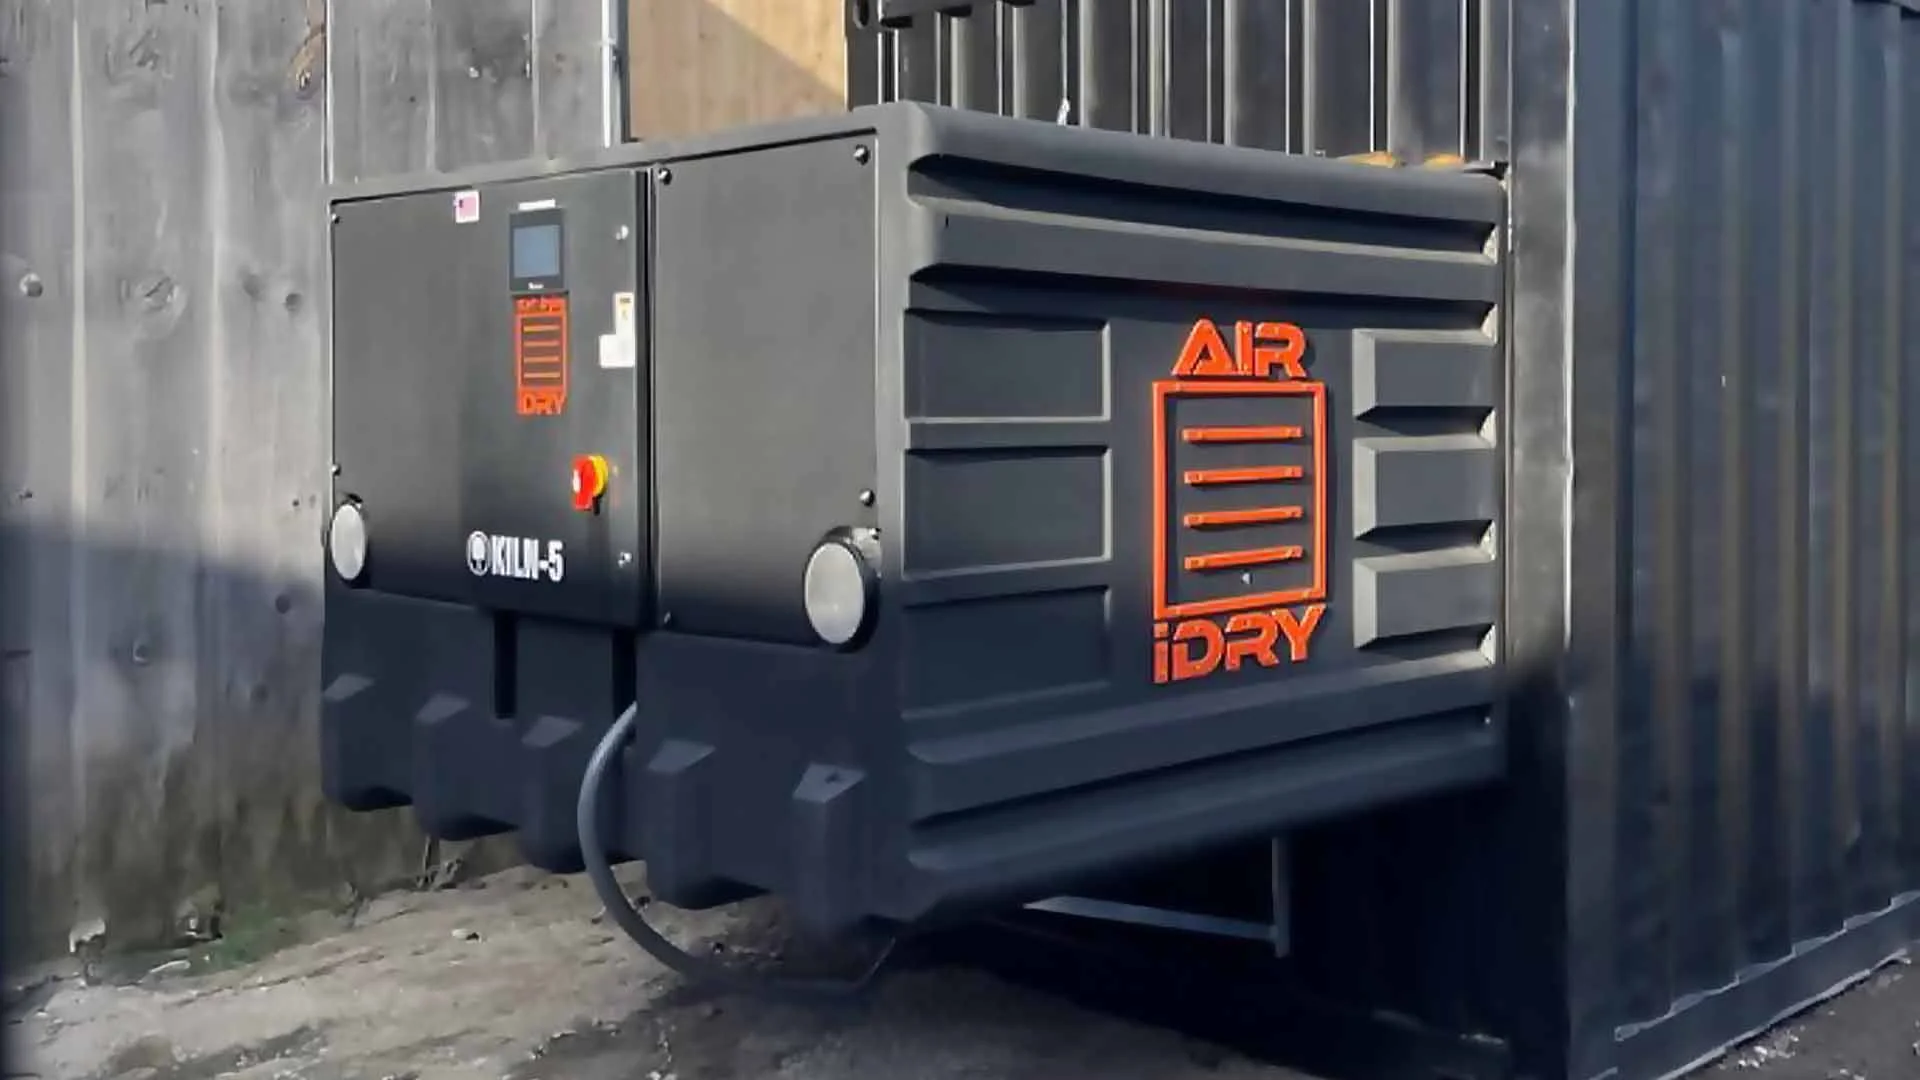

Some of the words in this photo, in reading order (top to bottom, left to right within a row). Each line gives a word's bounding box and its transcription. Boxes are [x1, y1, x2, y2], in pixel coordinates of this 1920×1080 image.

[1172, 318, 1307, 376] AIR
[491, 535, 564, 582] KILN-5
[1153, 603, 1326, 683] iDRY
